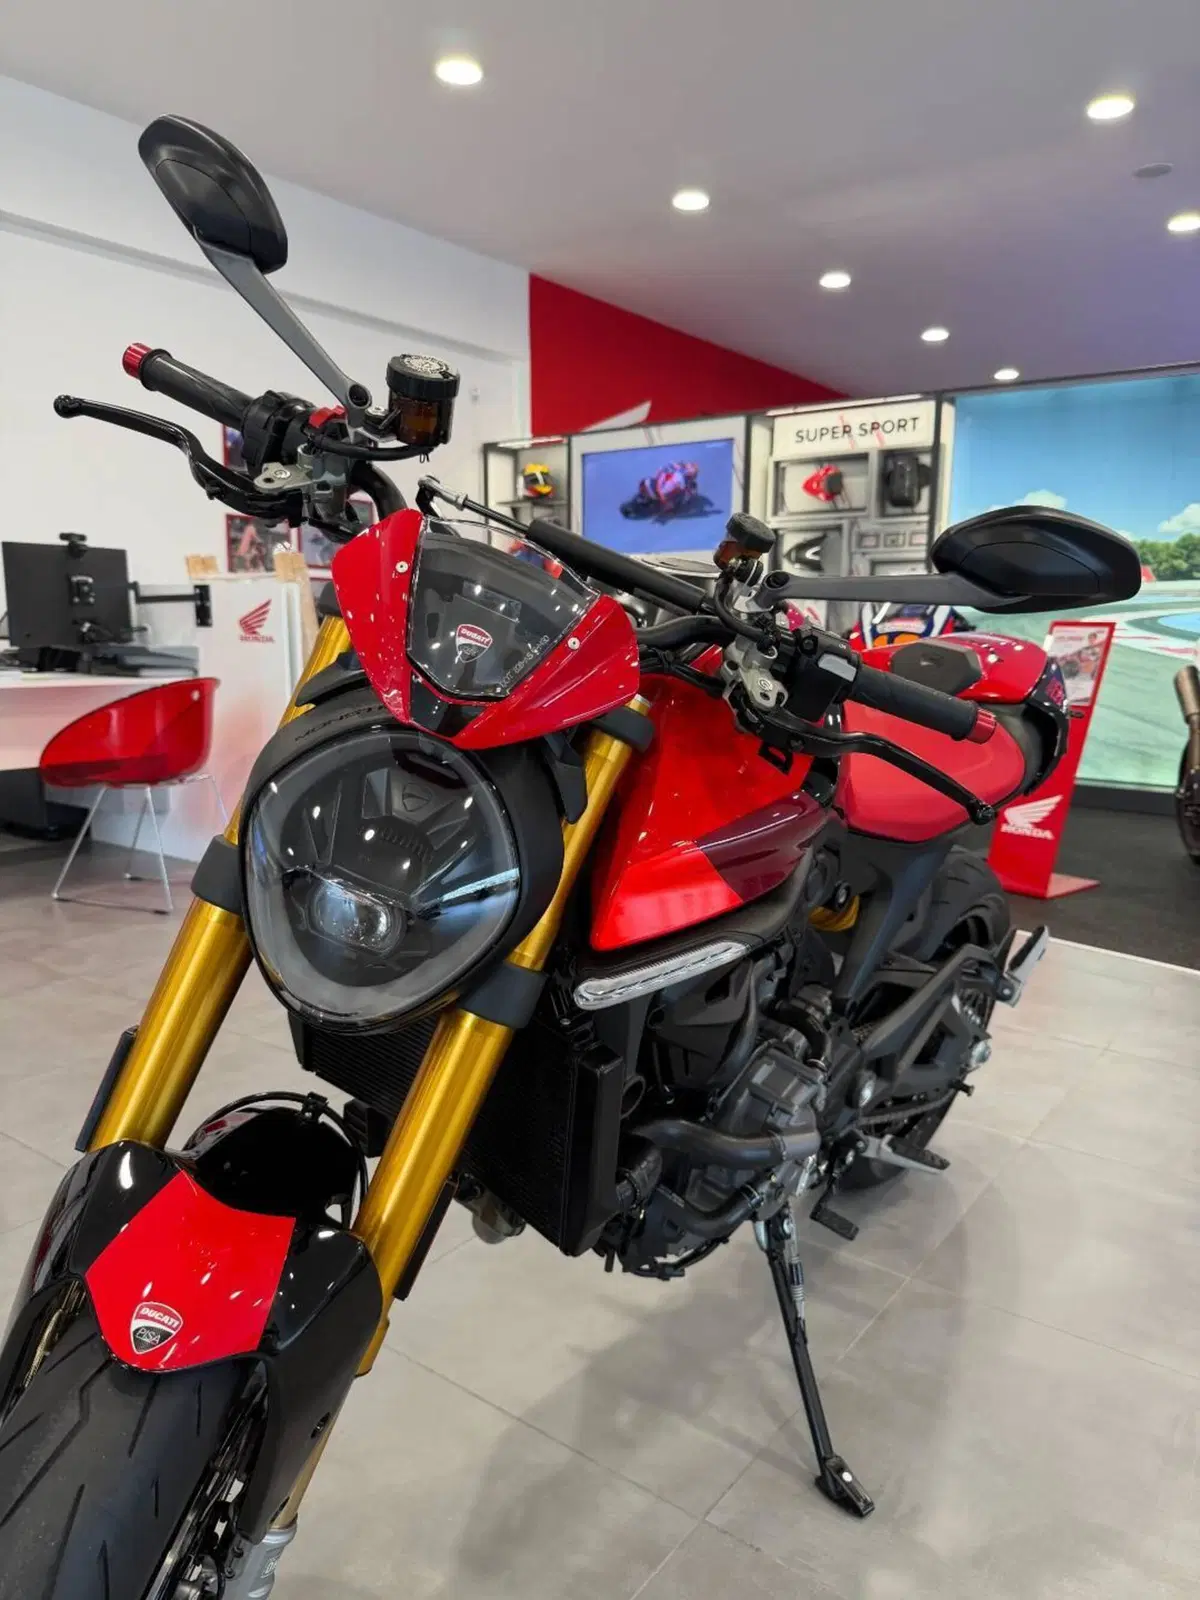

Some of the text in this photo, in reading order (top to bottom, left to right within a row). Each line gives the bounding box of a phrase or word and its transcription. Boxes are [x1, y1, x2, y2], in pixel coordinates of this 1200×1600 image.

[795, 417, 919, 443] SUPER SPORT
[460, 628, 490, 645] DUCATI
[1000, 823, 1055, 840] HONDA
[140, 1307, 180, 1328] DUCATI
[135, 1327, 161, 1345] PISA
